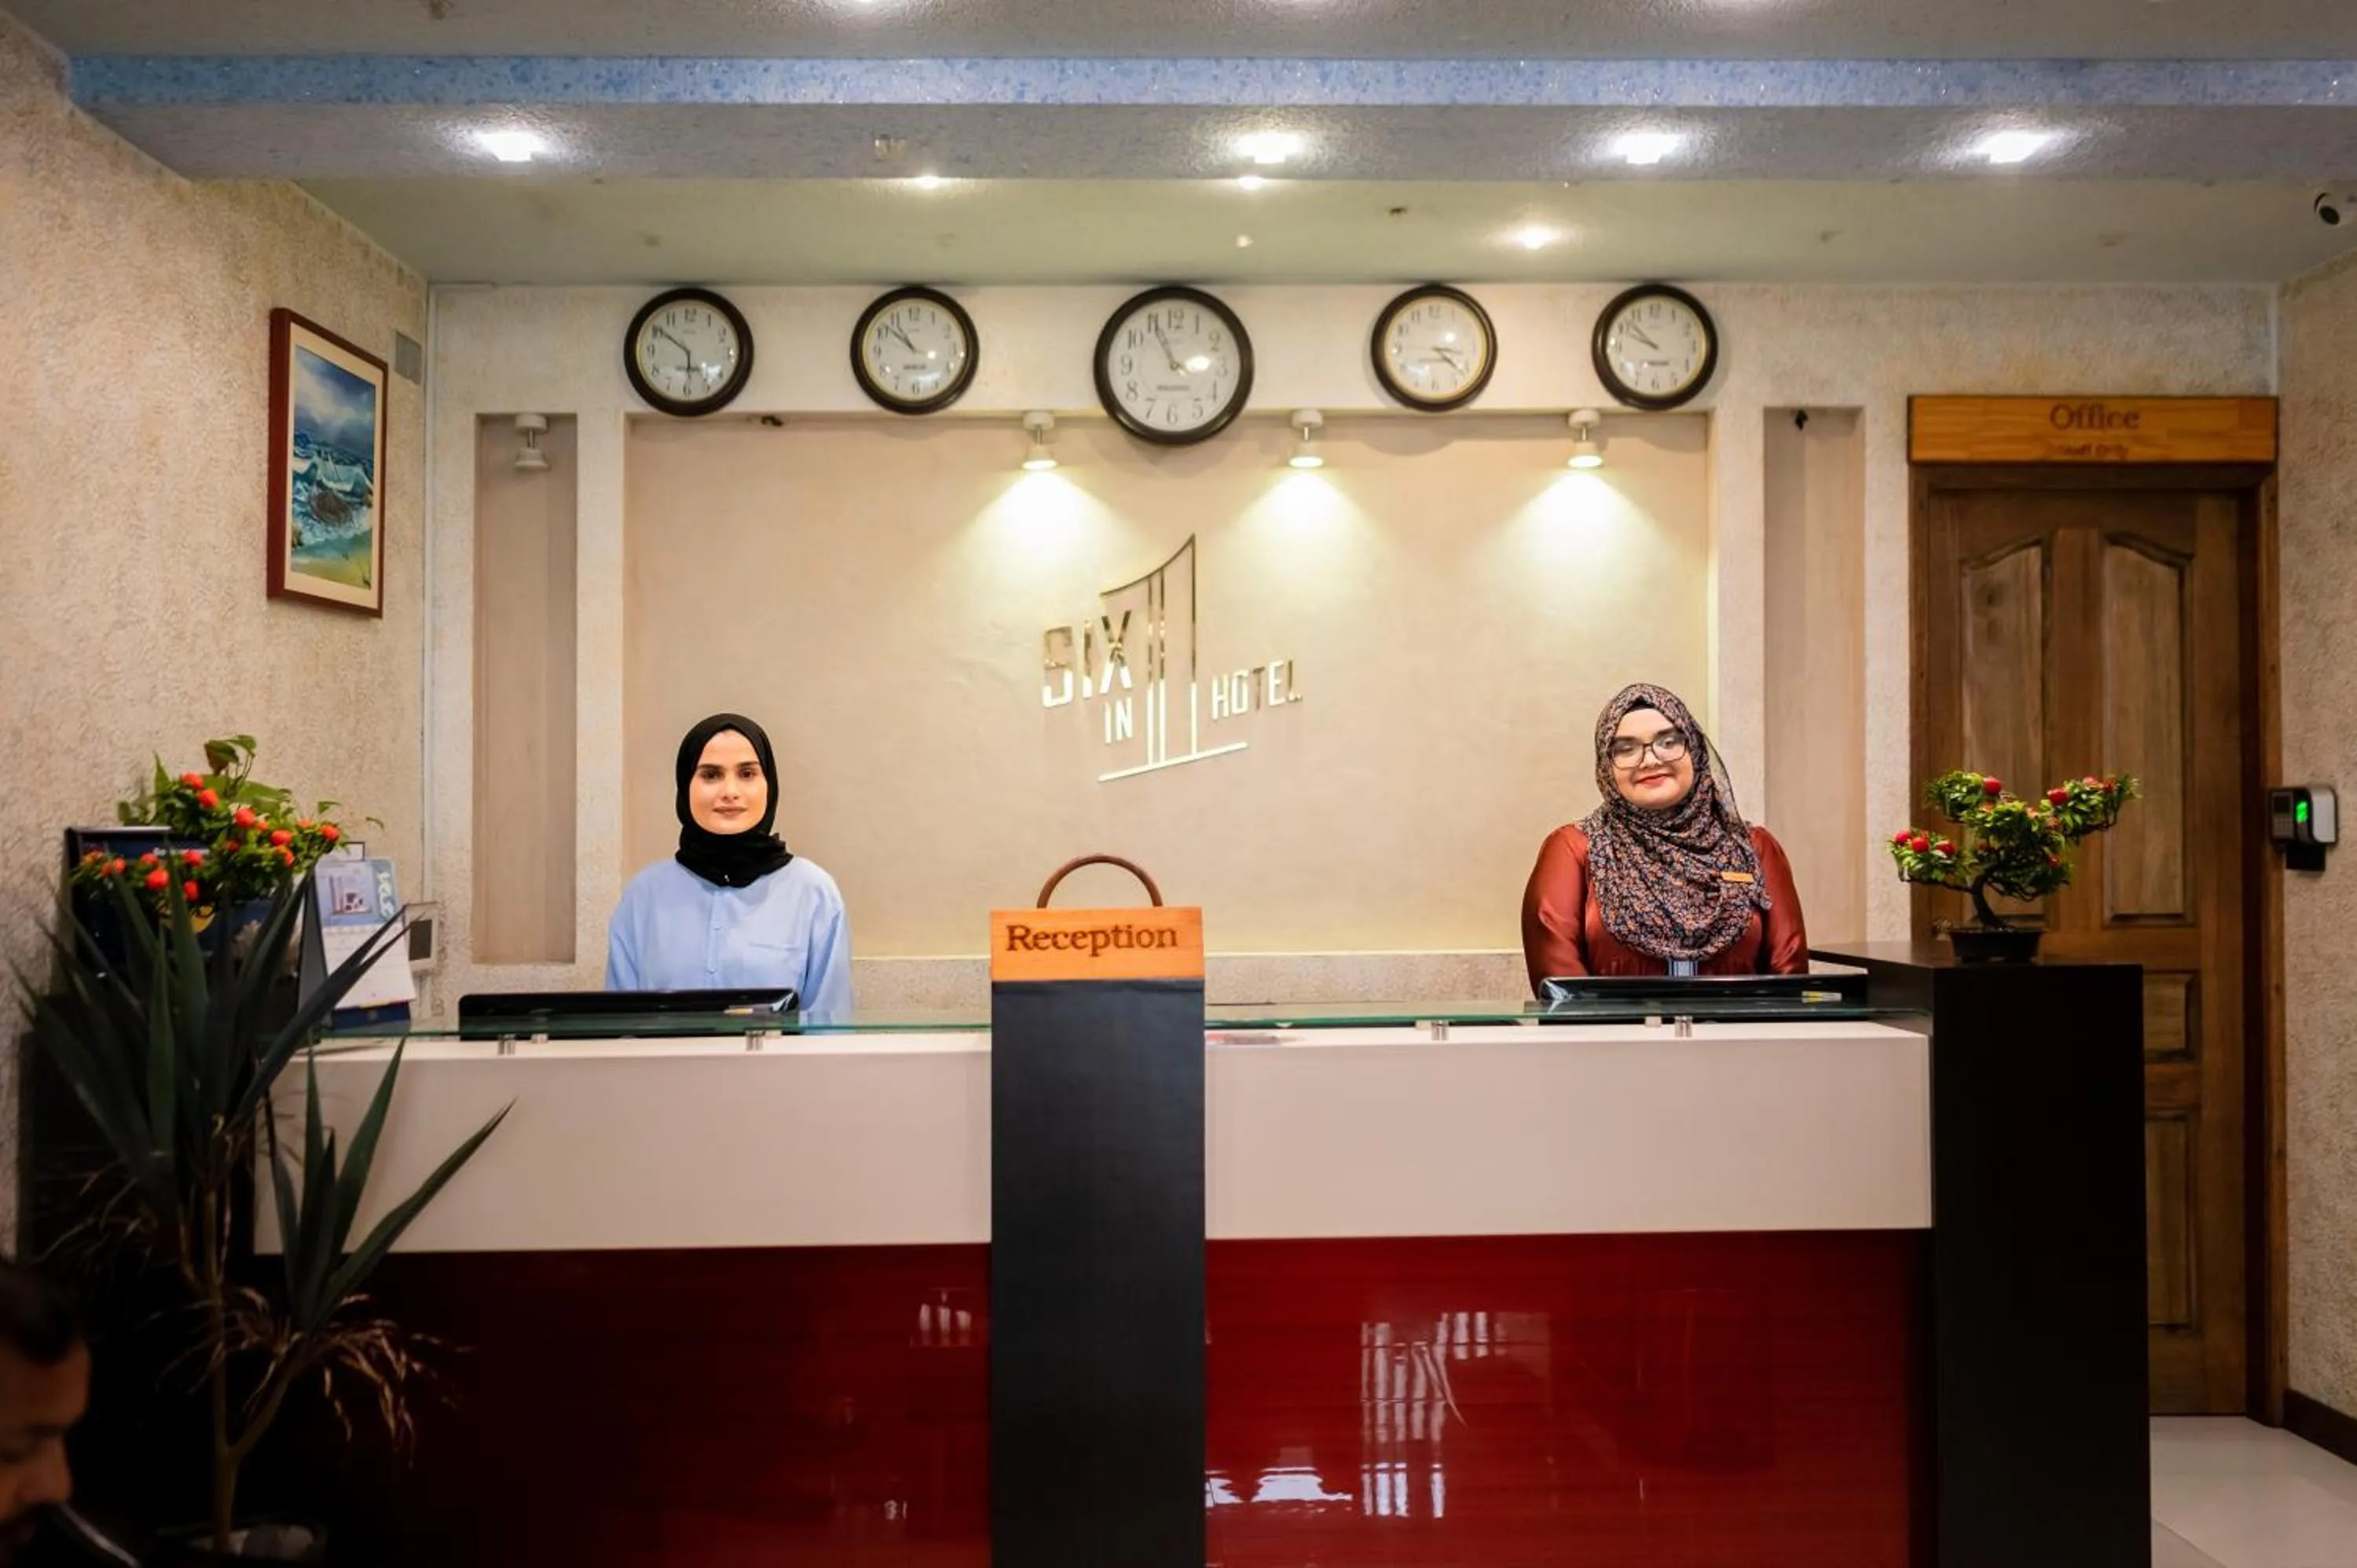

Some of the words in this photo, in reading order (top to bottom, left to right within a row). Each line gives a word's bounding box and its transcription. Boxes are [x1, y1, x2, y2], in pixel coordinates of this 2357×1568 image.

[1168, 309, 1184, 330] 12
[1127, 329, 1143, 350] 10
[1209, 329, 1221, 352] 2
[1120, 354, 1132, 376] 9
[1216, 356, 1227, 377] 3
[1126, 380, 1138, 401] 8
[1146, 397, 1156, 420] 7
[1167, 403, 1178, 425] 6
[1192, 397, 1203, 419] 5
[2050, 402, 2139, 430] Office
[1043, 609, 1132, 708] SIX
[1211, 659, 1303, 720] HOTEL
[1104, 697, 1133, 744] IN
[1006, 924, 1178, 958] Reception
